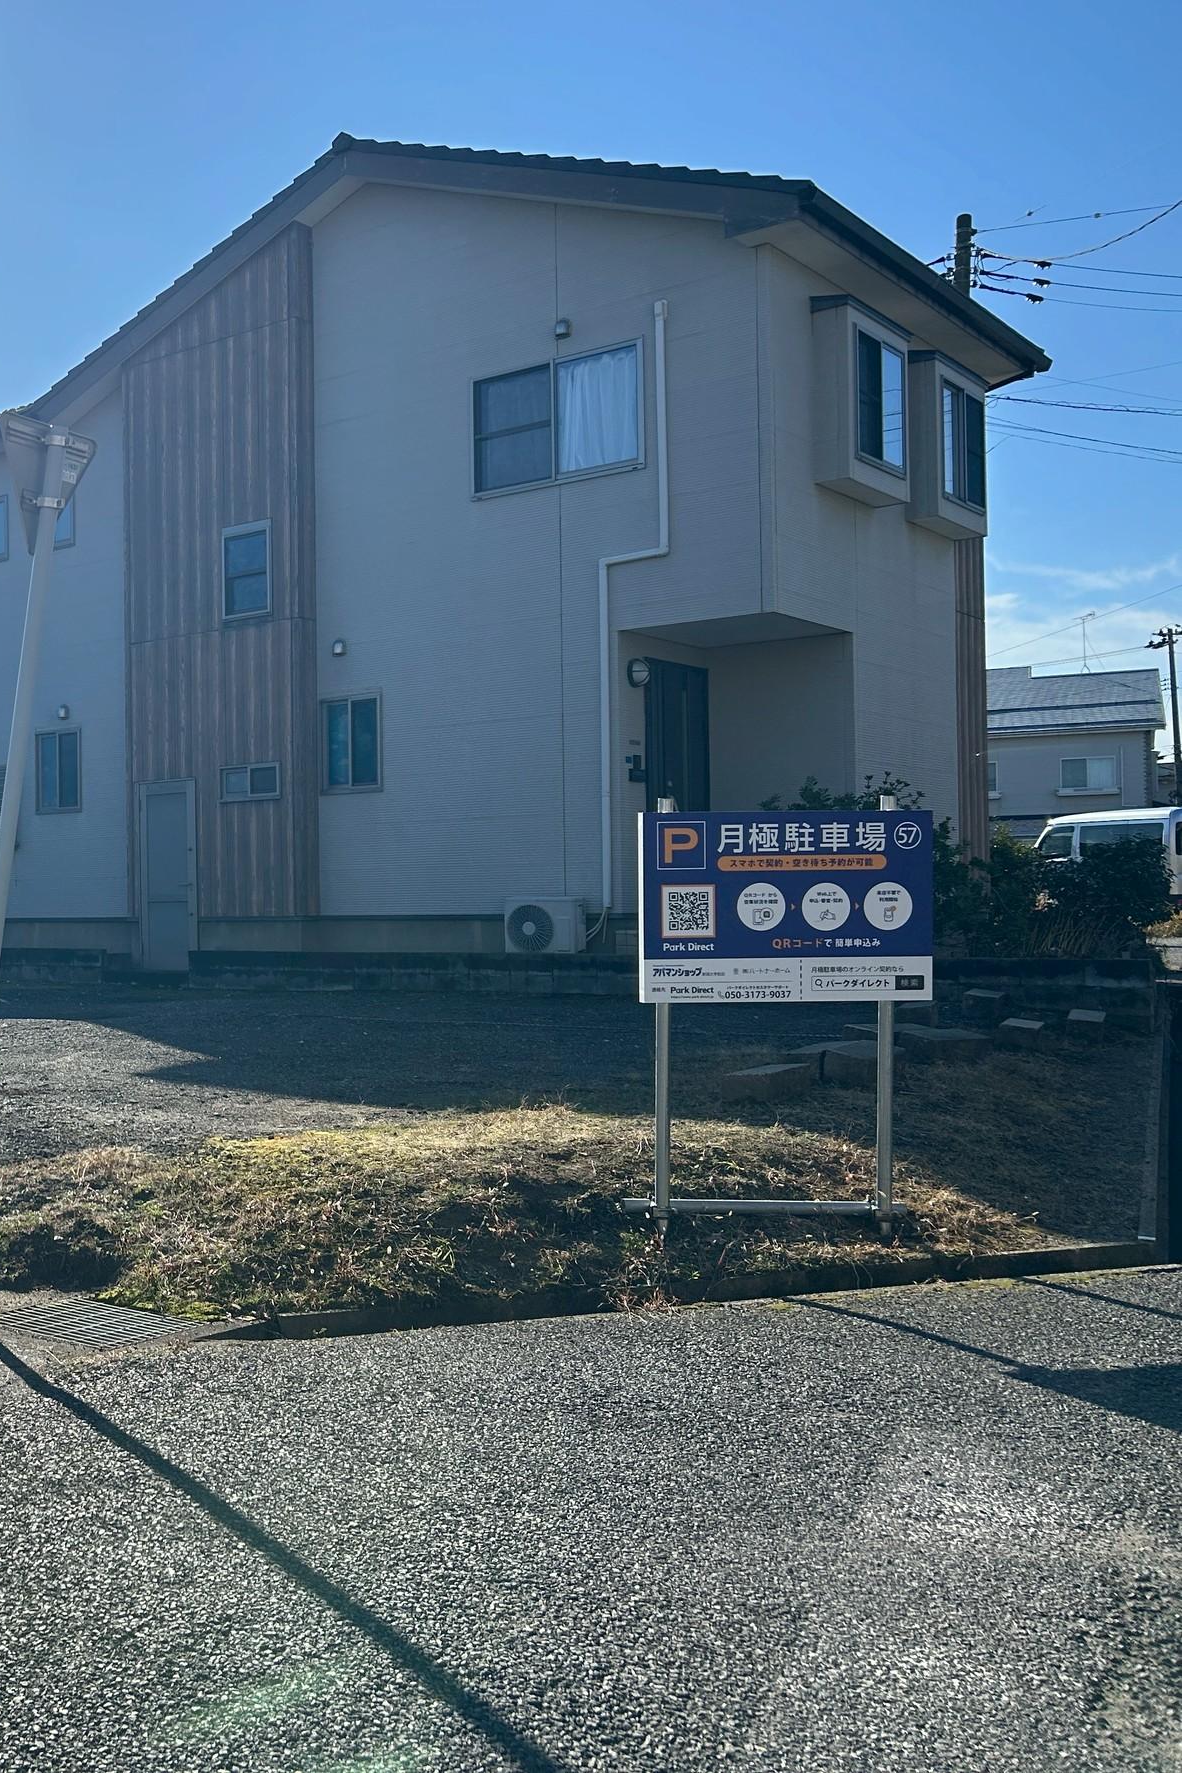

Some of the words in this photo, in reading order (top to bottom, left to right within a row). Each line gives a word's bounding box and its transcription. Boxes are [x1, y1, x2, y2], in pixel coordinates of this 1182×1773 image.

[717, 821, 887, 853] 月極駐車場
[897, 827, 917, 844] 57
[664, 827, 699, 864] P
[663, 943, 686, 952] Park
[687, 942, 715, 952] Direct
[826, 978, 890, 988] パークダイレクト
[670, 986, 690, 994] Park
[691, 986, 714, 994] Direct
[724, 990, 792, 999] 050-3173-9037
